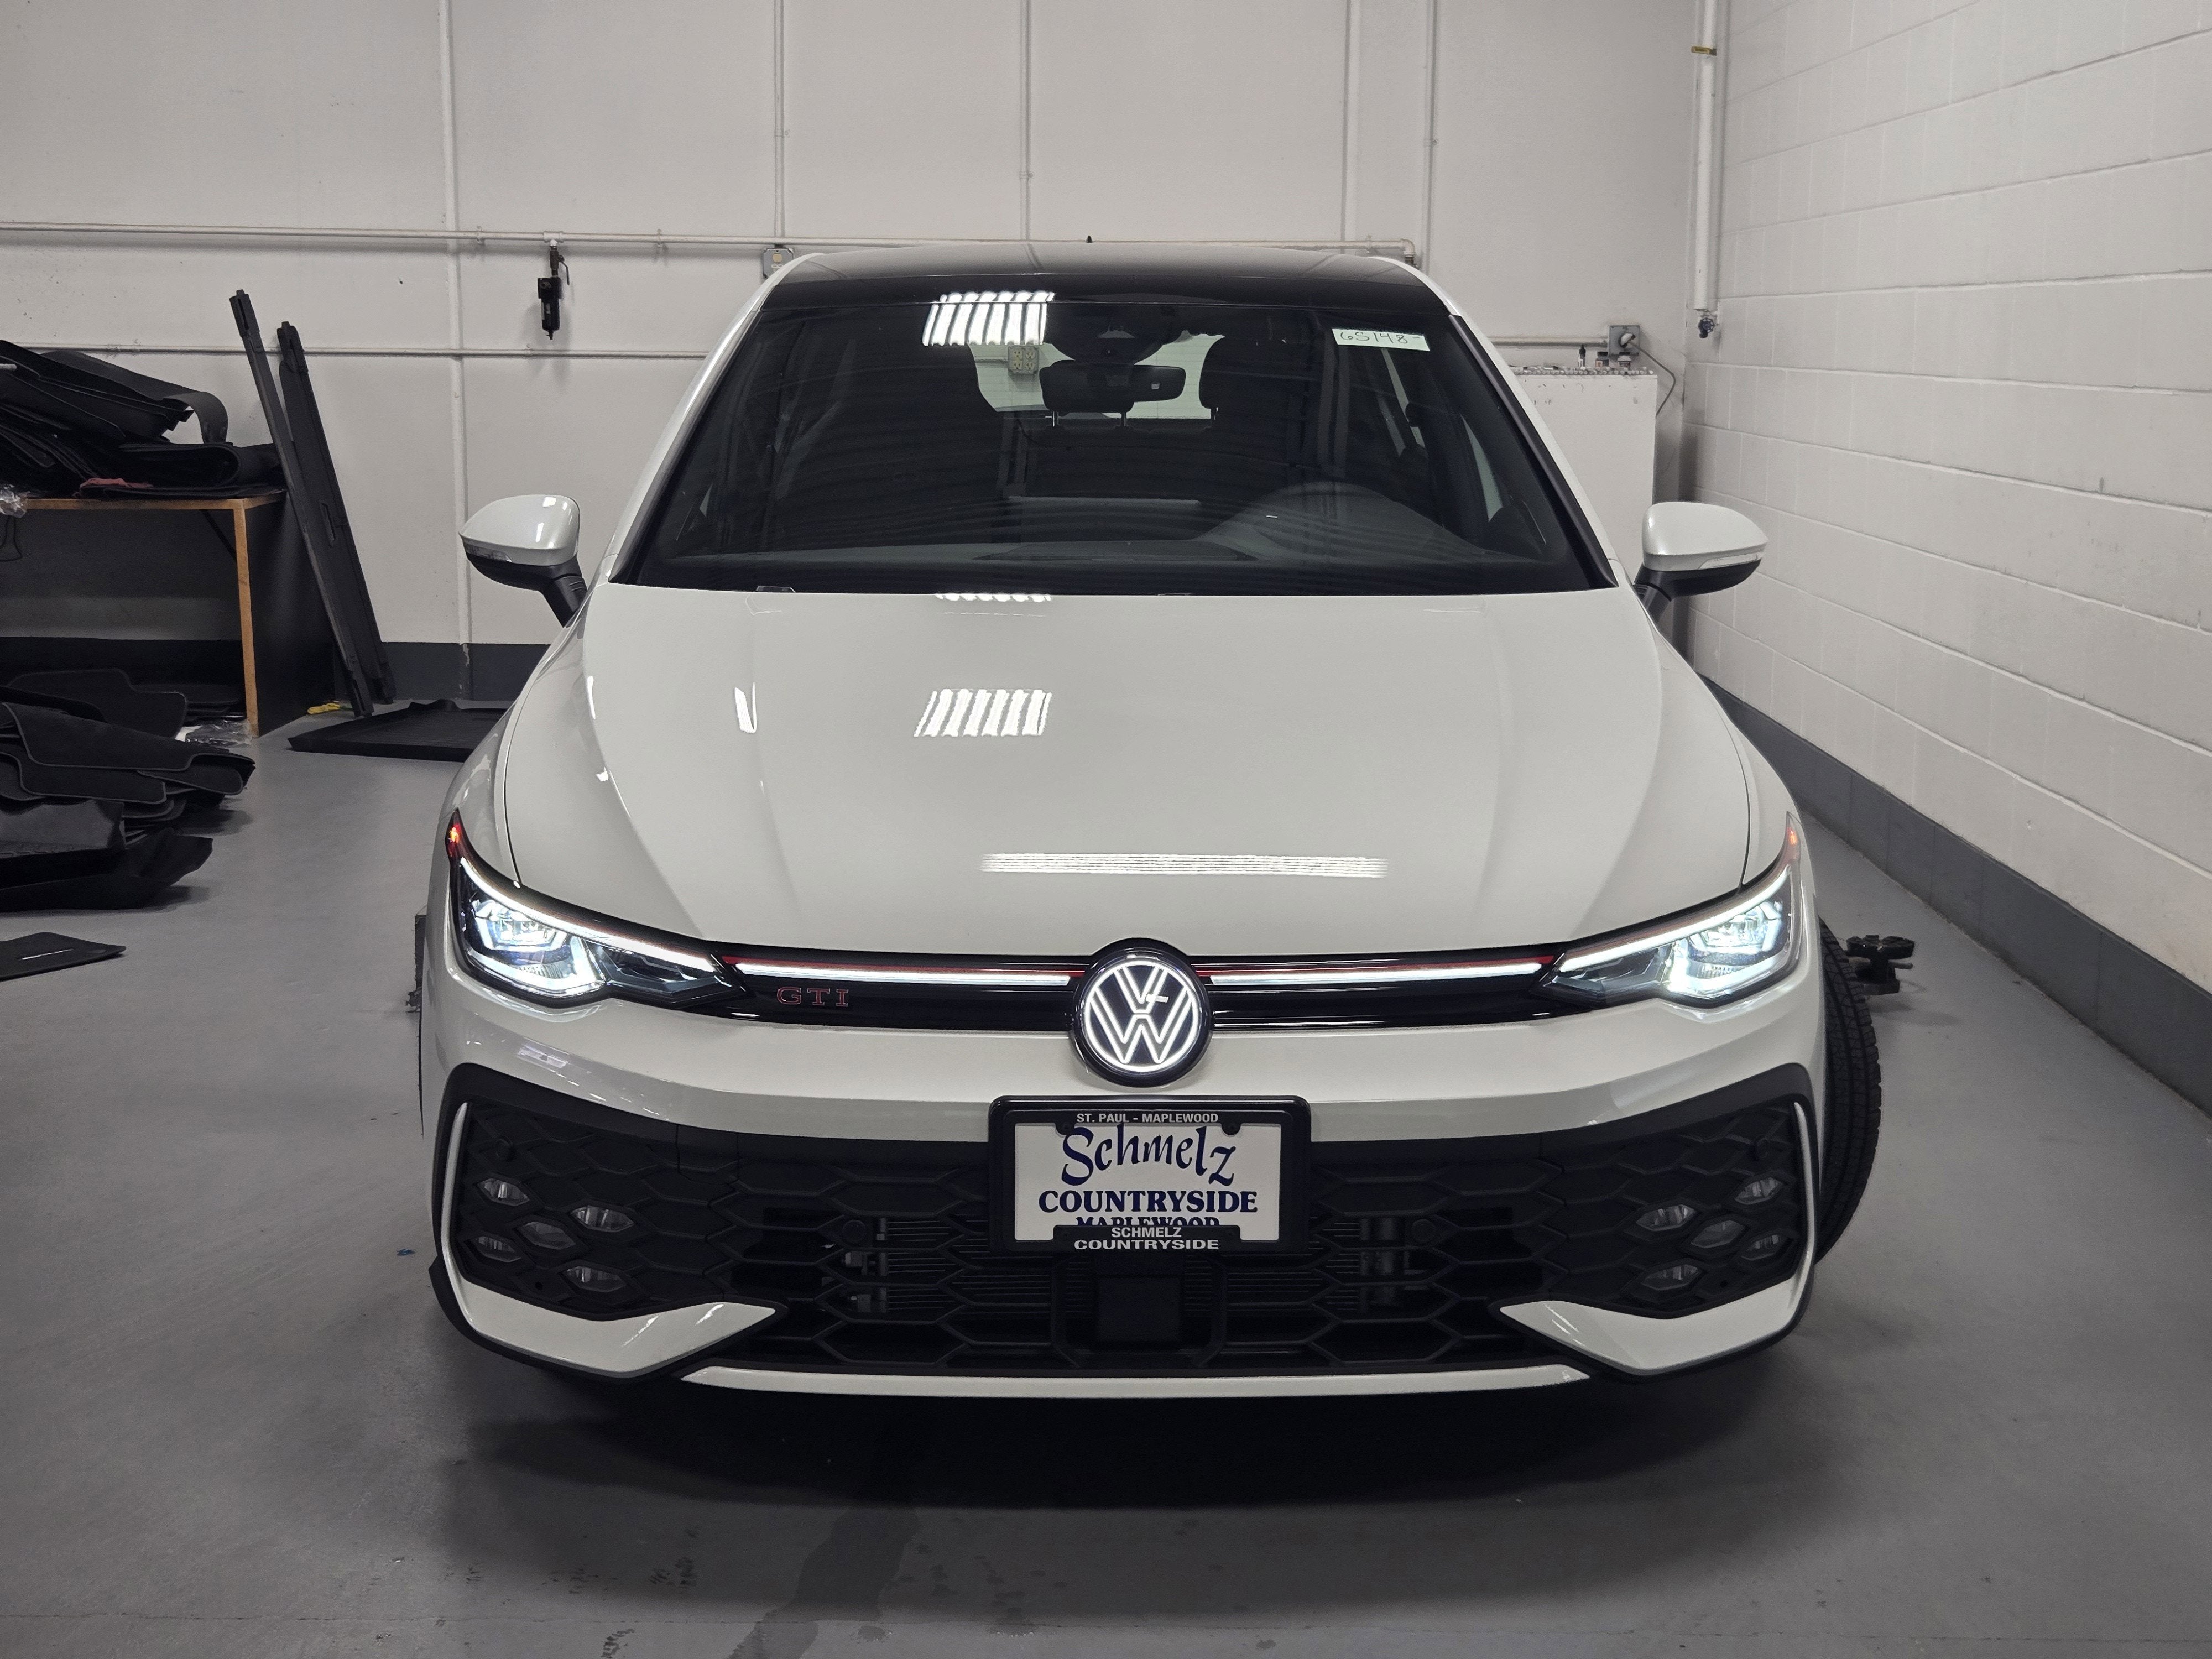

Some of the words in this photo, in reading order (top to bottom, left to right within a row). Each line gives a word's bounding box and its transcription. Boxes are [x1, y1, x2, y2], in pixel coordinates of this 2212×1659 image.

[776, 986, 849, 1007] GTI
[1077, 1113, 1095, 1123] ST.
[1099, 1113, 1129, 1123] PAUL
[1142, 1113, 1218, 1123] MAPLEWOOD
[1061, 1123, 1236, 1186] Schmelz
[1039, 1190, 1258, 1213] COUNTRYSIDE
[1112, 1227, 1182, 1237] SCHMELZ
[1074, 1240, 1219, 1249] COUNTRYSIDE
